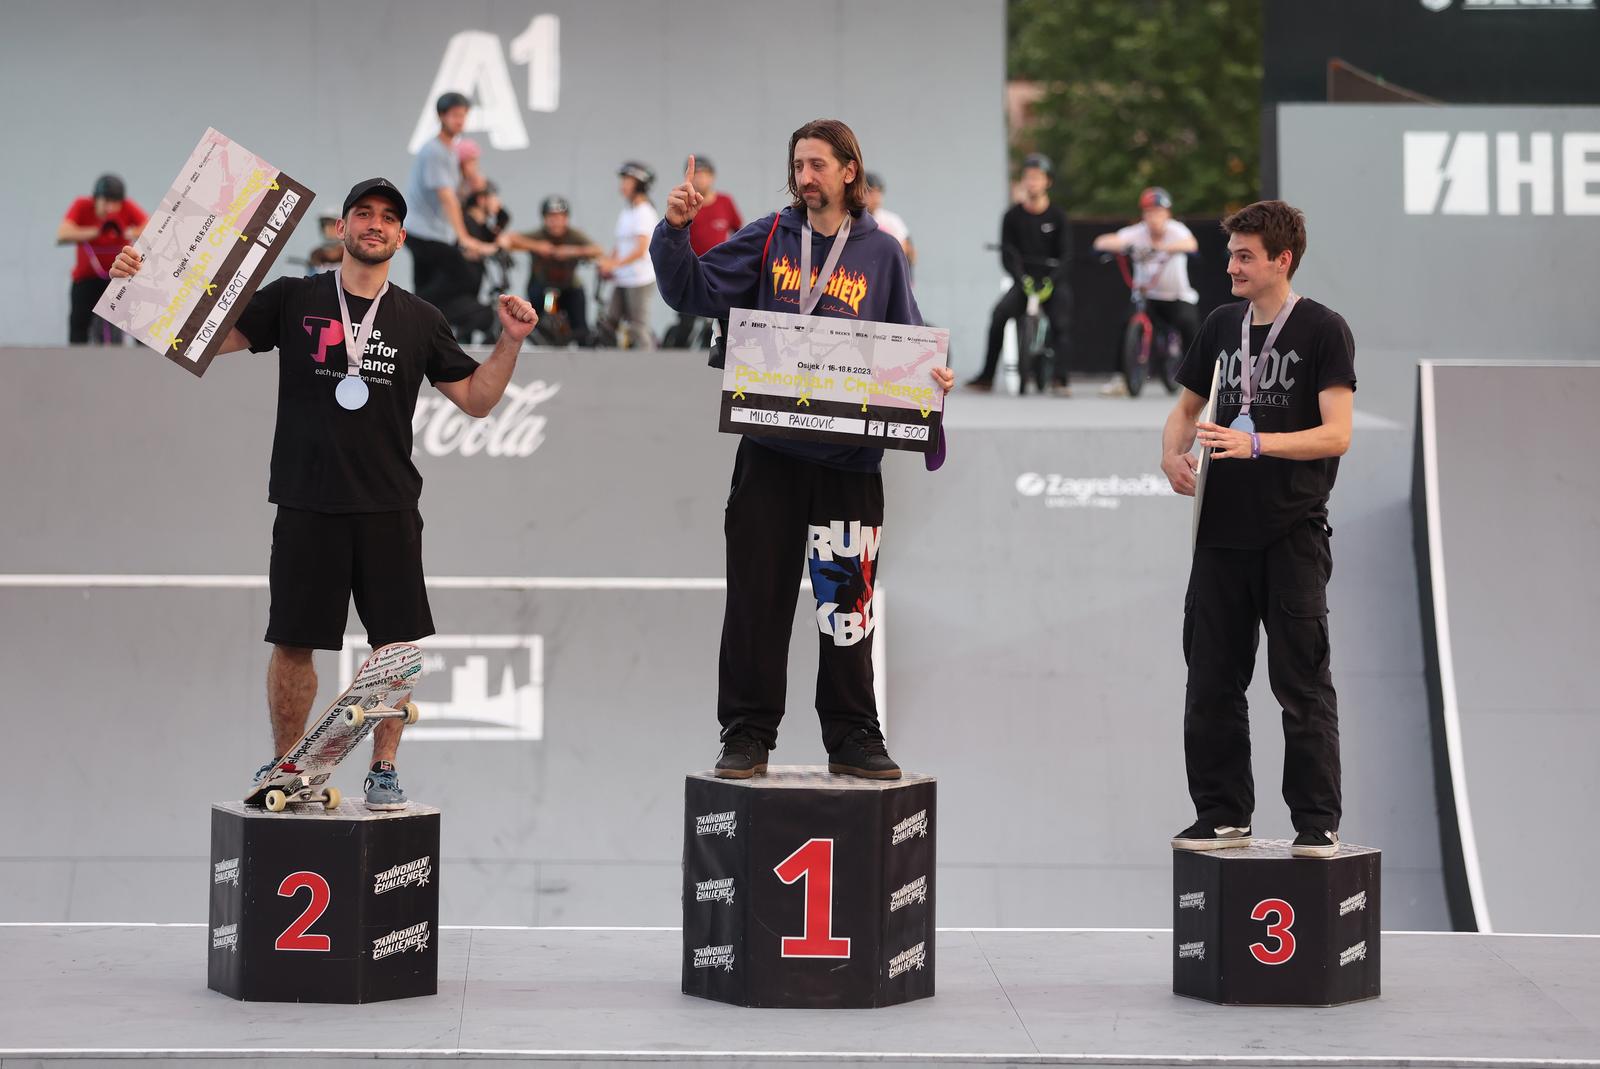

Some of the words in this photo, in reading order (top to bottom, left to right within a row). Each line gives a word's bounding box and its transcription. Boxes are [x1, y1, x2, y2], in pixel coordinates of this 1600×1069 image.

[407, 13, 561, 154] A1
[278, 194, 297, 217] 250
[266, 233, 275, 244] 2
[150, 250, 215, 341] Pannonian
[207, 168, 267, 248] Challenge
[172, 253, 190, 278] Osijek
[196, 319, 217, 344] TONI
[217, 270, 249, 312] DESPOT
[314, 367, 331, 378] each
[797, 361, 820, 371] Osijek
[735, 364, 835, 390] Pannonian
[843, 376, 936, 401] Challenge
[749, 409, 780, 425] MILOŠ
[788, 414, 836, 430] PAVLOVIĆ
[872, 425, 879, 436] 1
[902, 426, 928, 439] 500
[696, 811, 736, 825] PANNONIAN
[696, 821, 736, 835] CHALLENGE
[892, 809, 926, 834] PANNONIAN
[892, 820, 928, 845] CHALLENGE
[374, 856, 430, 884] PANNONIAN
[374, 866, 431, 895] CHALLENGE
[696, 878, 734, 892] PANNONIAN
[696, 887, 735, 901] CHALLENGE
[890, 875, 926, 900] PANNONIAN
[773, 838, 851, 958] 1
[890, 886, 927, 912] CHALLENGE
[275, 871, 331, 952] 2
[372, 921, 428, 949] PANNONIAN
[1249, 898, 1296, 965] 3
[372, 932, 430, 961] CHALLENGE
[694, 945, 734, 958] PANNONIAN
[889, 941, 925, 966] PANNONIAN
[694, 954, 735, 968] CHALLENGE
[888, 952, 926, 979] CHALLENGE
